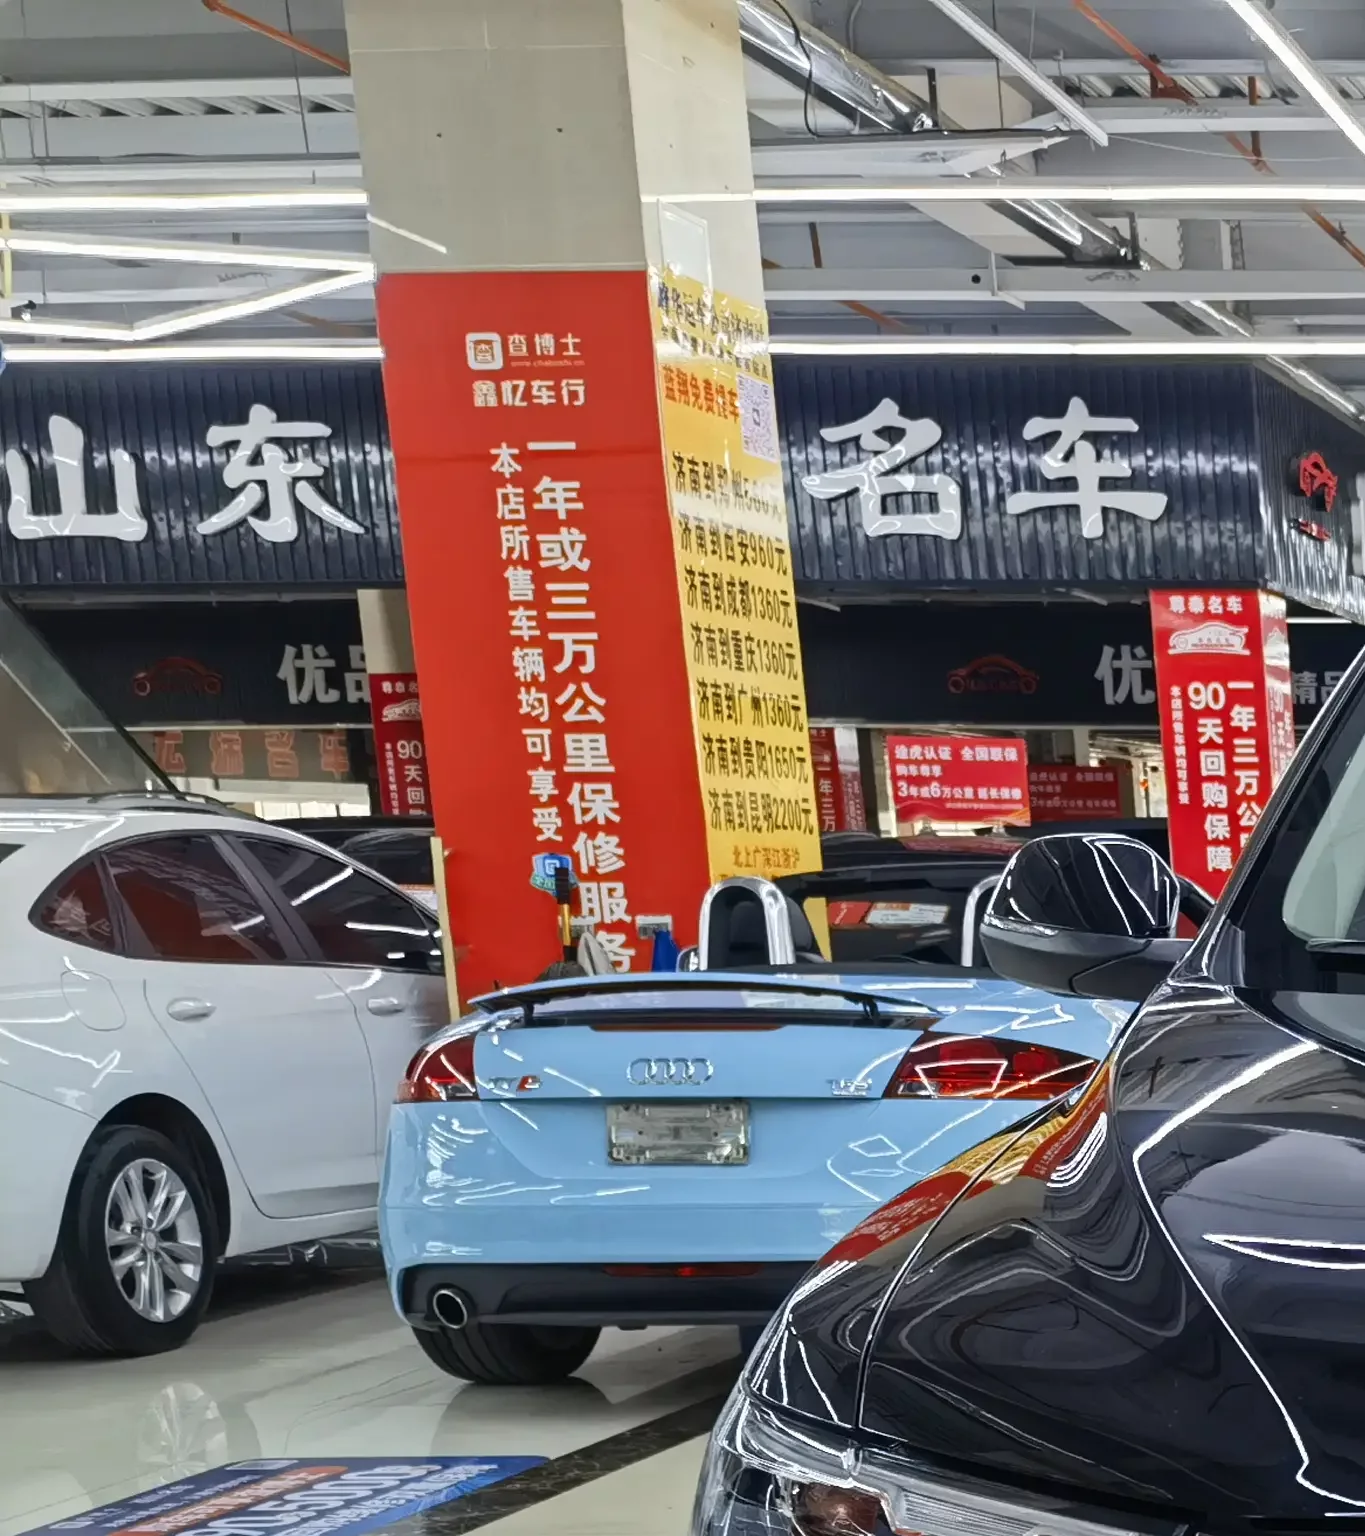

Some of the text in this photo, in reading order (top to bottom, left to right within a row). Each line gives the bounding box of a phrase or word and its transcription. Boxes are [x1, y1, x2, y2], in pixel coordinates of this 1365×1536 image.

[507, 333, 581, 357] 查博士
[6, 403, 366, 542] 山东
[802, 396, 1168, 541] 名车
[684, 565, 794, 629] 济南到成都1360元
[490, 442, 564, 842] 本店所售车辆均可享受
[690, 621, 799, 681] 济南到重庆1360元
[527, 441, 636, 974] 一年或三万公里保修服务
[696, 677, 804, 733] 济南到广州1360元
[397, 740, 427, 816] 90天回
[702, 732, 809, 784] 济南到贵阳1650元
[1188, 681, 1233, 872] 90天回购保障
[708, 788, 814, 835] 济南到昆明2200元
